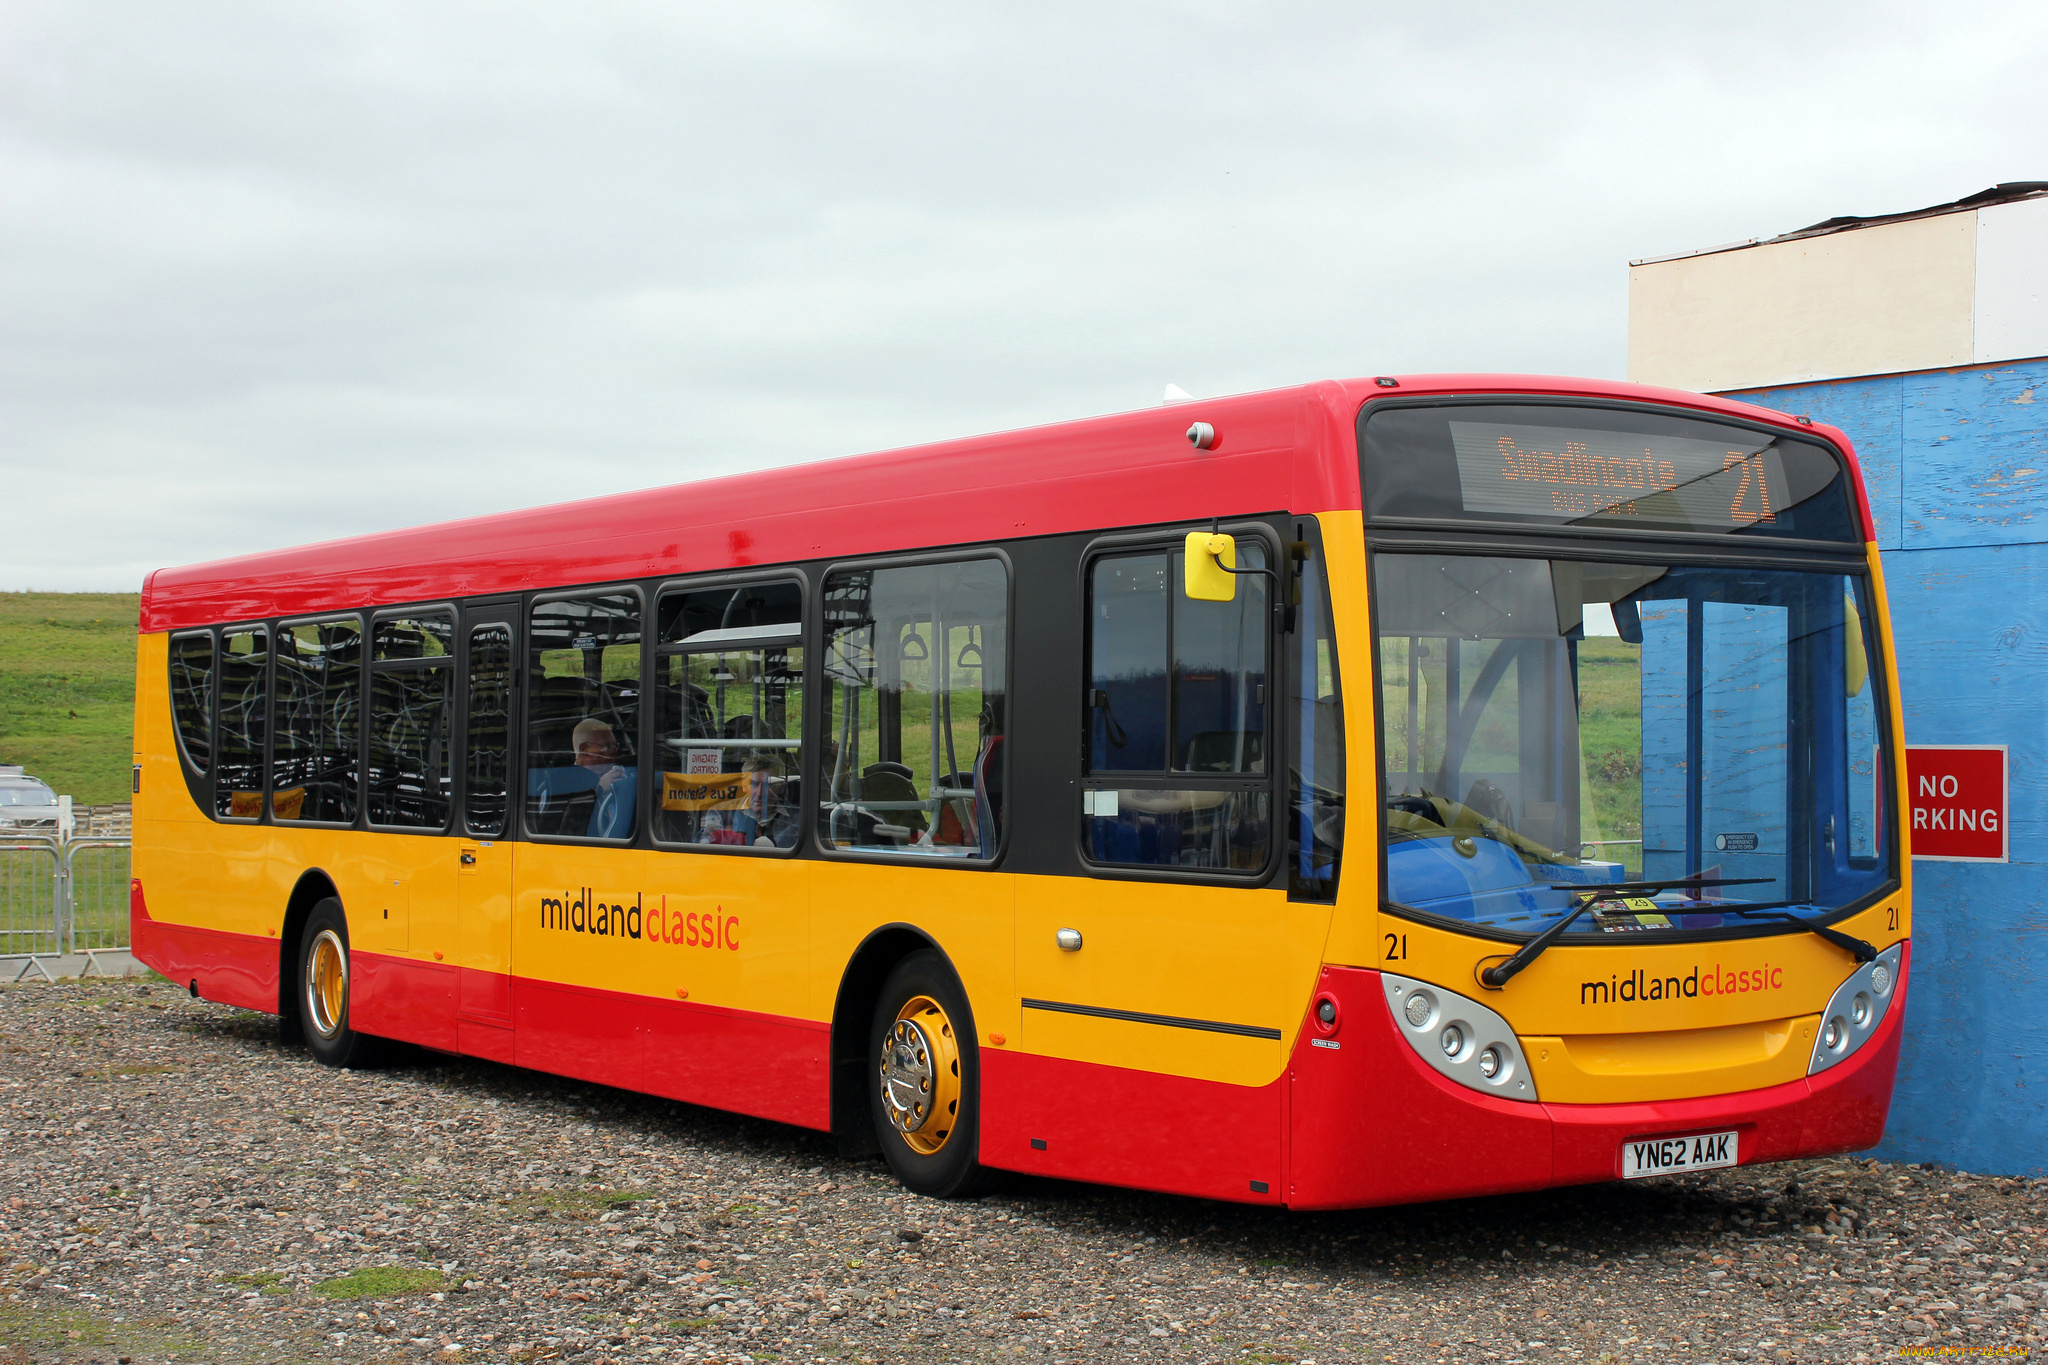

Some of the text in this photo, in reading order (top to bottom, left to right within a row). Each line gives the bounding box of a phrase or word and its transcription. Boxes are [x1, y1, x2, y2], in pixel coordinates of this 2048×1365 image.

[1722, 450, 1777, 524] 21
[1919, 774, 1959, 798] NO
[1913, 807, 1998, 833] RKING
[1630, 898, 1649, 907] 29
[541, 886, 739, 951] midlandclassic
[1886, 906, 1900, 931] 21
[1384, 933, 1407, 960] 21
[1580, 962, 1783, 1005] midlandclassic
[1634, 1135, 1729, 1169] YN62 AAK
